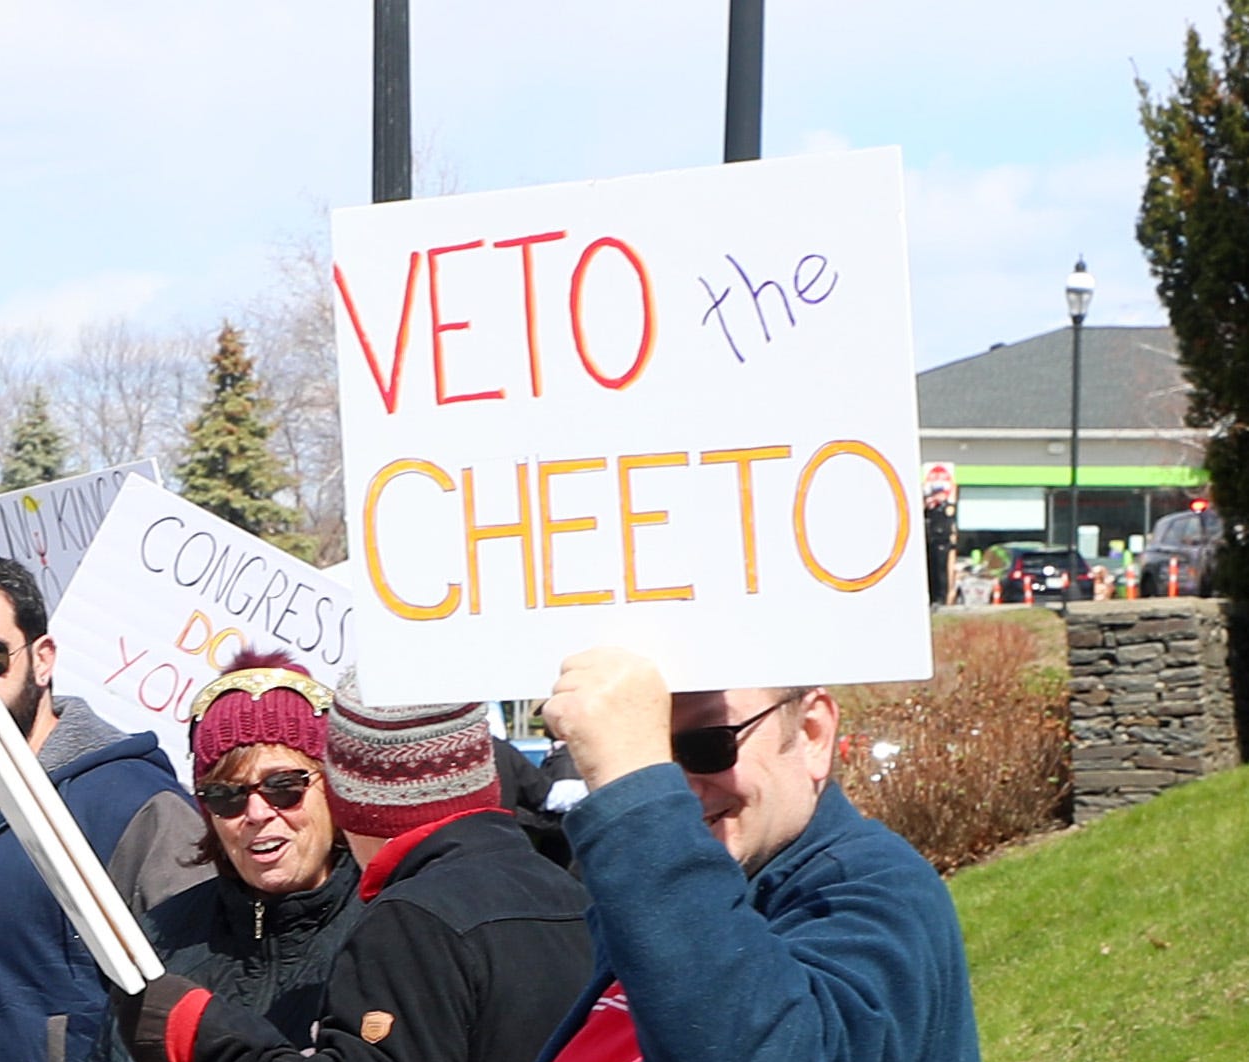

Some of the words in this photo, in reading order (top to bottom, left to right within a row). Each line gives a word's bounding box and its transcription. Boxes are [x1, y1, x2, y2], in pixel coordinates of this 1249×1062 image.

[332, 230, 657, 414] VETO
[698, 253, 839, 364] the
[141, 516, 353, 665] CONGRESS
[363, 439, 910, 622] CHEETO
[176, 609, 247, 672] DO
